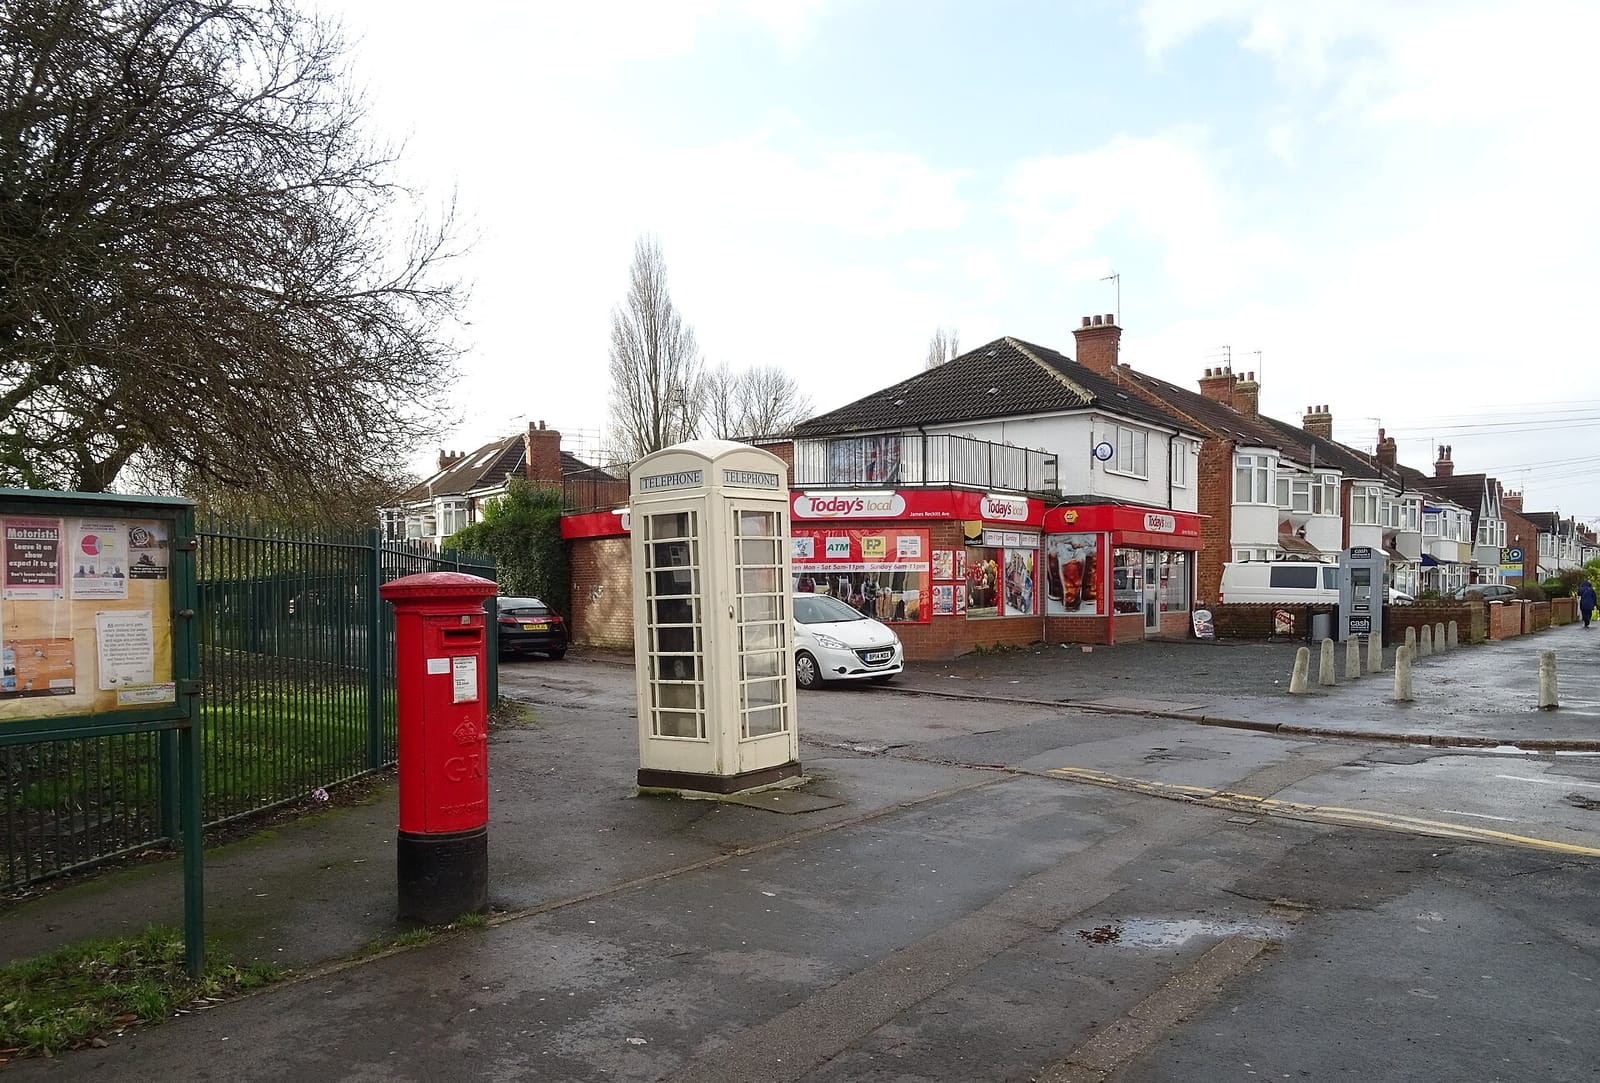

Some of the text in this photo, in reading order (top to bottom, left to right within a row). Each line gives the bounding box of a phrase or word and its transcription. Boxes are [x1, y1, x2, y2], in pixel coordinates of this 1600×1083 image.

[643, 471, 700, 489] TELEPHONE
[725, 471, 776, 486] TELEPHONE
[808, 496, 892, 515] Today's local
[987, 499, 1012, 518] Today's
[1148, 514, 1165, 530] Today's
[7, 527, 58, 540] Motorists!
[14, 543, 35, 551] Leave
[36, 543, 42, 551] it
[826, 543, 849, 552] ATM
[8, 560, 31, 568] expect
[48, 561, 58, 569] go
[832, 563, 865, 572] 5am-11pm
[870, 563, 892, 572] Sunday
[893, 563, 926, 572] 6am-11pm
[1350, 619, 1370, 629] cash
